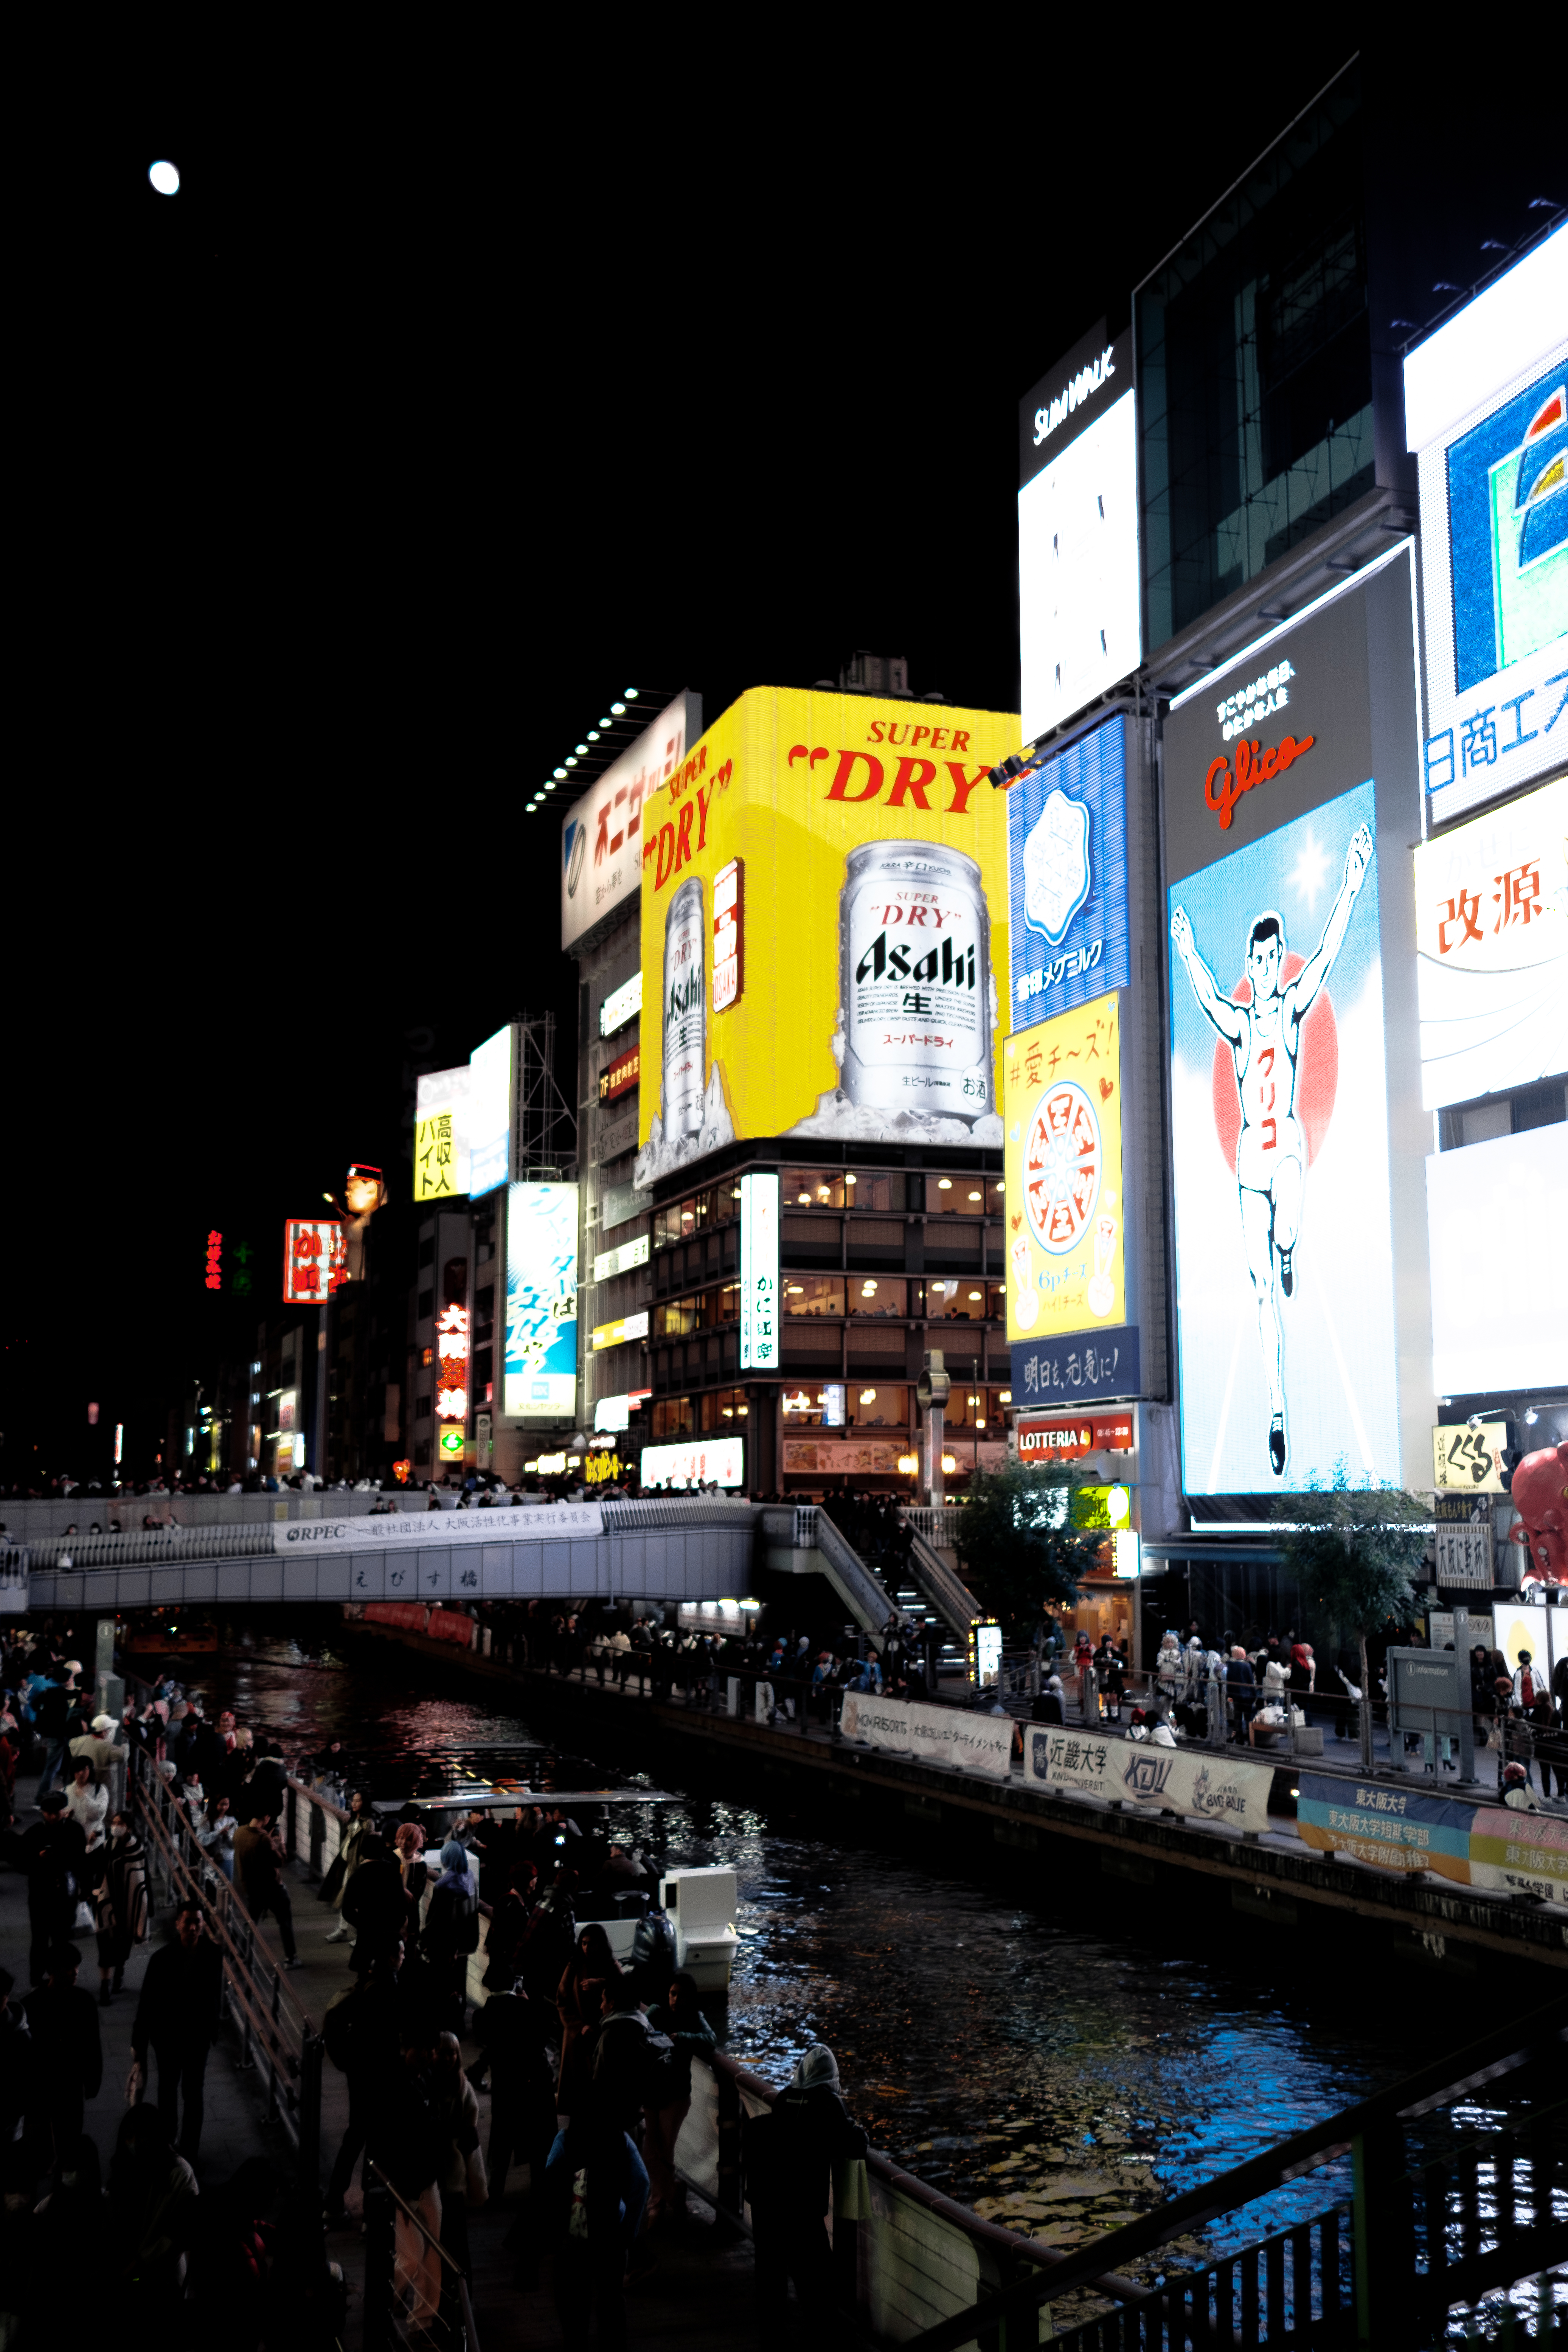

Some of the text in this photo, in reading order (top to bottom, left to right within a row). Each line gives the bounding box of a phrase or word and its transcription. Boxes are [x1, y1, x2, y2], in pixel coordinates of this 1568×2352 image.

[867, 720, 970, 752] SUPER
[669, 745, 708, 806] SUPER
[1205, 736, 1313, 830] Glico
[896, 892, 939, 904] SUPER
[1436, 857, 1543, 955] 改源
[855, 930, 975, 991] Asahi
[714, 963, 735, 1004] OSAKA
[902, 993, 932, 1015] 生
[883, 1034, 954, 1048] スーパードライ
[902, 1076, 933, 1088] 生ビール
[963, 1077, 986, 1100] お酒
[419, 1118, 436, 1196] バイト
[435, 1115, 452, 1193] 高収入
[533, 1385, 548, 1396] BX
[1020, 1430, 1078, 1451] LOTTERIA
[286, 1525, 346, 1542] ORPEC
[357, 1520, 440, 1536] 一般社団法人
[356, 1570, 478, 1588] えびす橋
[1049, 1737, 1108, 1774] 近畿大学
